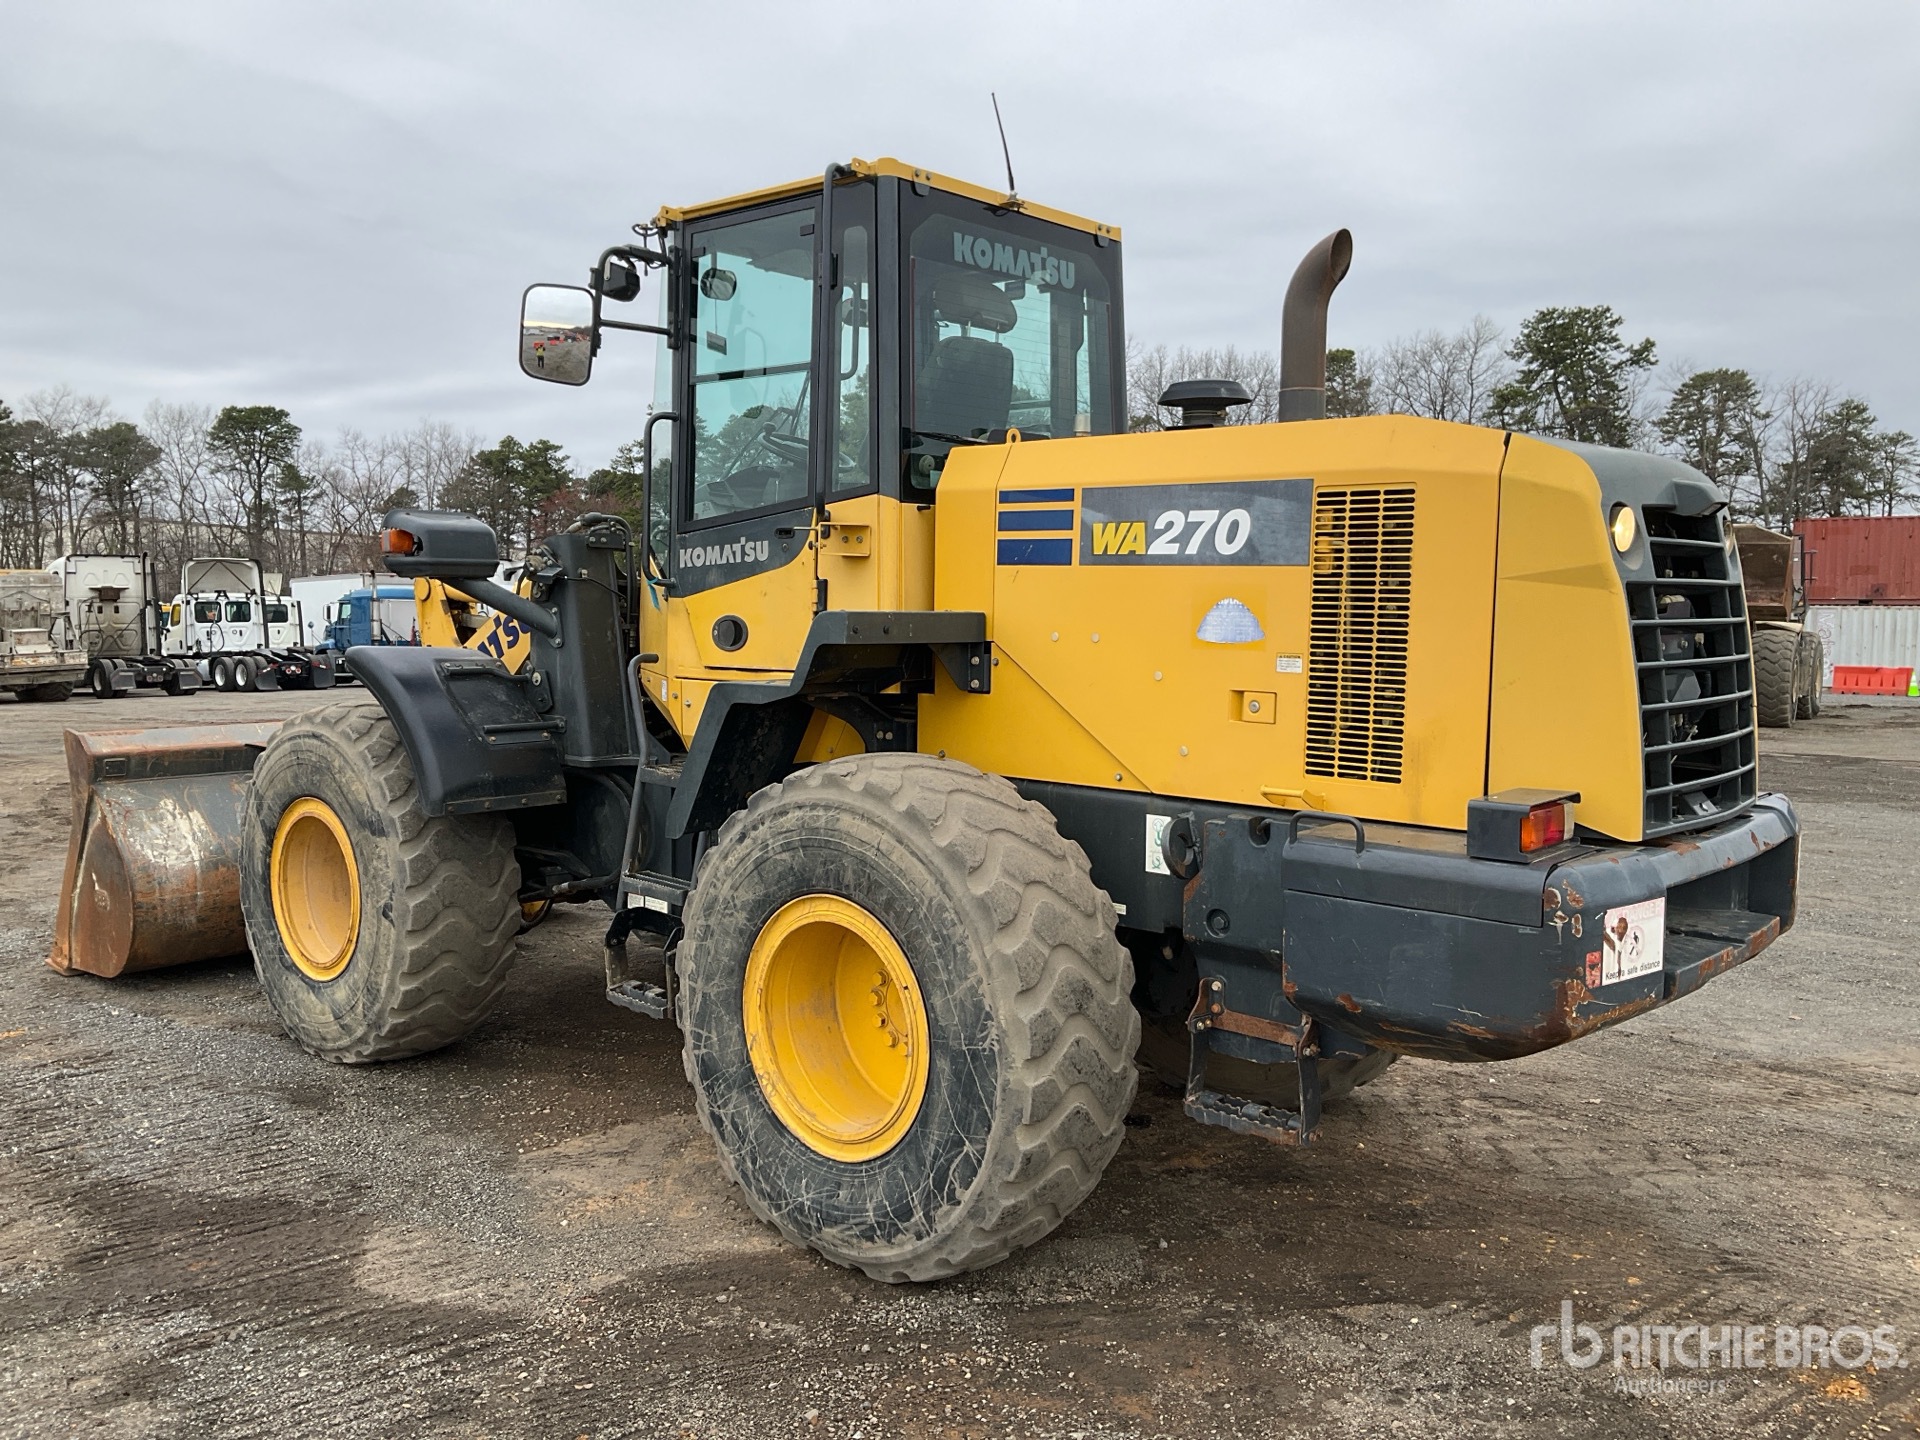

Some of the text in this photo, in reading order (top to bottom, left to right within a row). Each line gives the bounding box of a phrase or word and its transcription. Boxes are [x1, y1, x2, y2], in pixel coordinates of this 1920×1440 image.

[953, 231, 1075, 289] KOMATSU
[679, 536, 769, 570] KOMATSU
[1627, 965, 1638, 975] safe
[1640, 960, 1661, 972] distance
